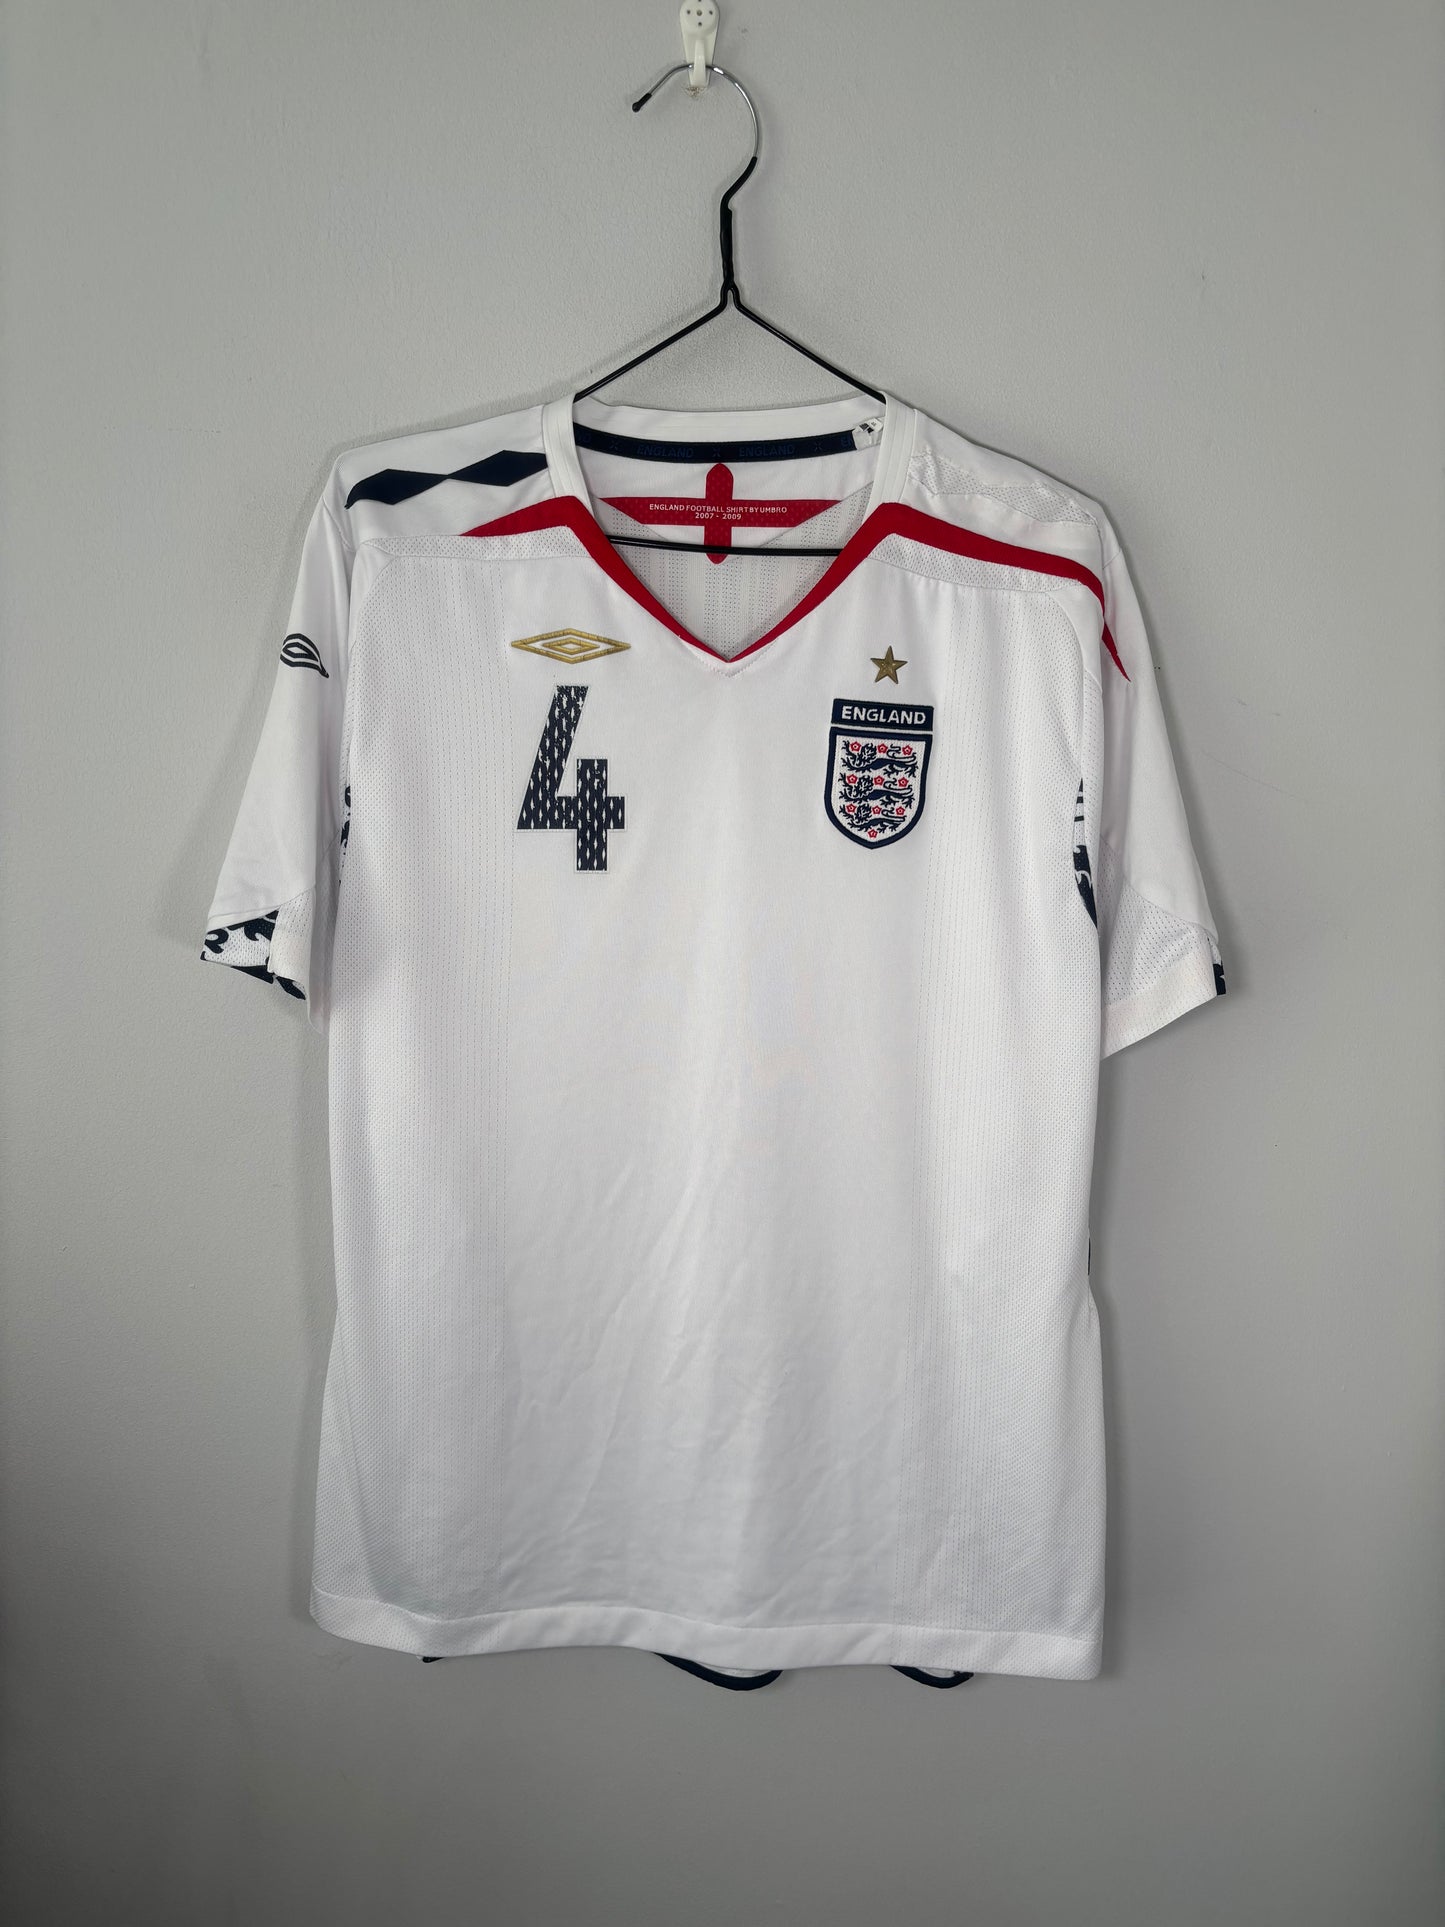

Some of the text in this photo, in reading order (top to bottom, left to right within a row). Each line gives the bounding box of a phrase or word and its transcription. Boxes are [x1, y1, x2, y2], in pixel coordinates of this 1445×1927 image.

[649, 503, 685, 511] ENGLAND
[686, 504, 725, 513] FOOTBALL
[726, 506, 748, 514] SHIRT
[841, 705, 926, 725] ENGLAND
[516, 684, 626, 872] 4
